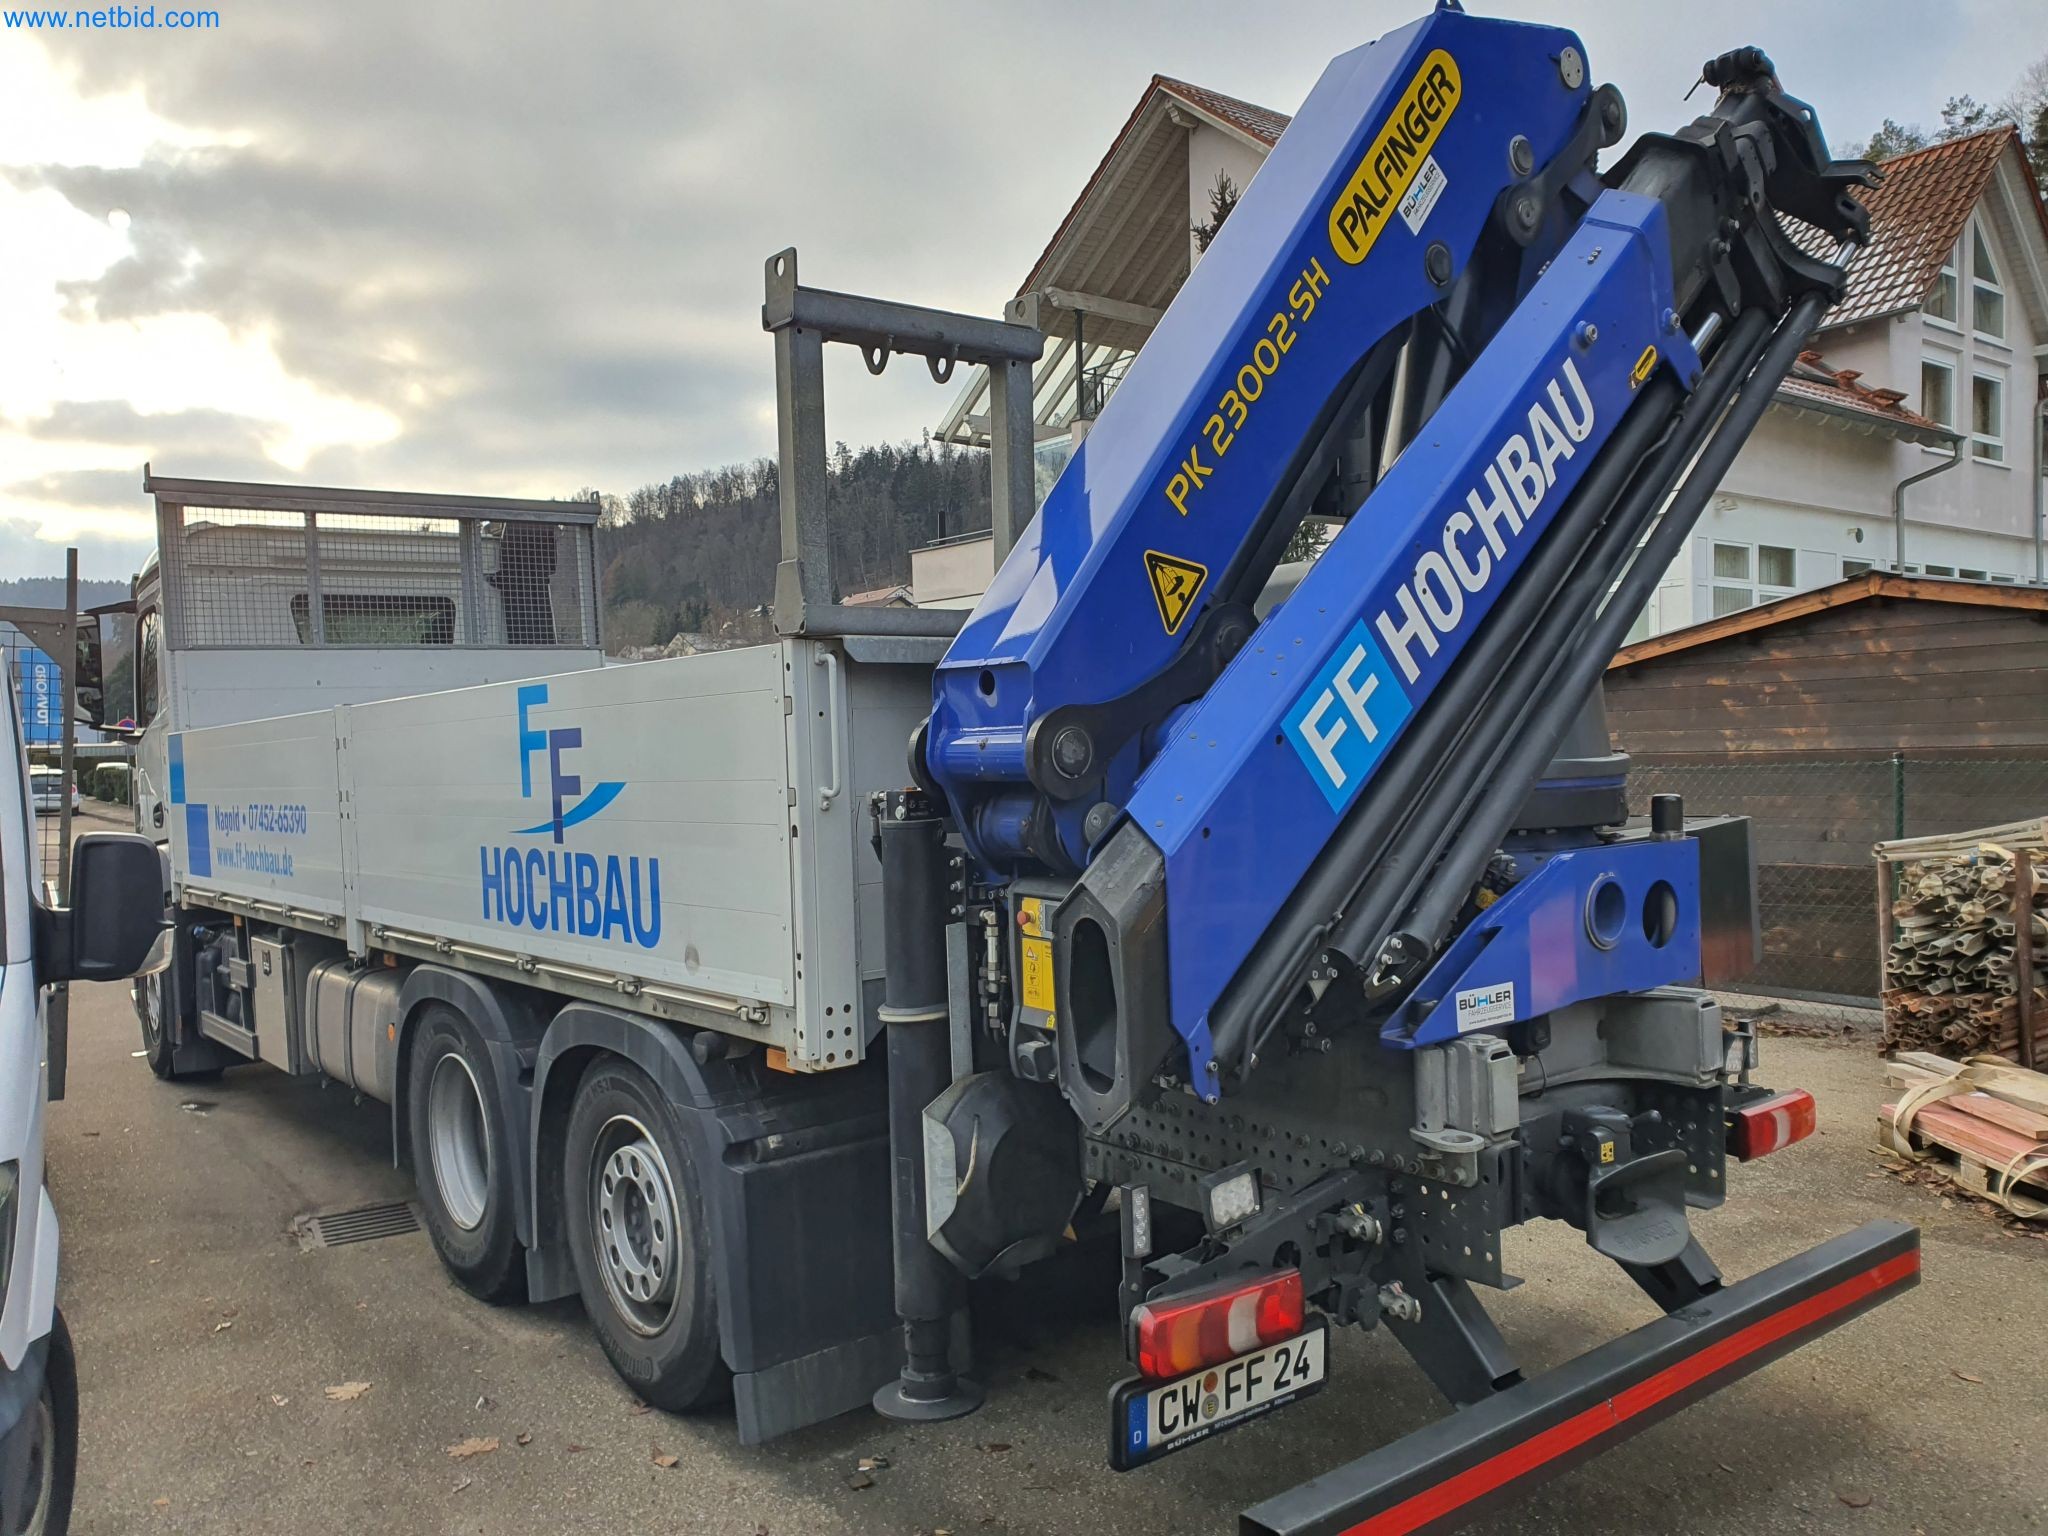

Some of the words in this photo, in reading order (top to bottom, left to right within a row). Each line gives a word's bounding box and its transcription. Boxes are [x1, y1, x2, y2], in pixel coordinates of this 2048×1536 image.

[1336, 63, 1456, 253] PALFINGER
[1402, 162, 1437, 219] BÜHLER
[1165, 444, 1214, 516] PK
[1299, 643, 1379, 789] FF
[1375, 357, 1595, 684] HOCHBAU
[214, 805, 241, 837] Nagold
[248, 804, 307, 835] 07452-65390
[216, 842, 294, 877] www.ff-hochbau.de
[480, 845, 662, 949] HOCHBAU
[1459, 990, 1511, 1010] BÜHLER
[1158, 1379, 1202, 1435] CW
[1225, 1355, 1265, 1410] FF
[1273, 1340, 1311, 1391] 24
[1133, 1430, 1142, 1444] D
[1167, 1428, 1210, 1450] BÜHLER
